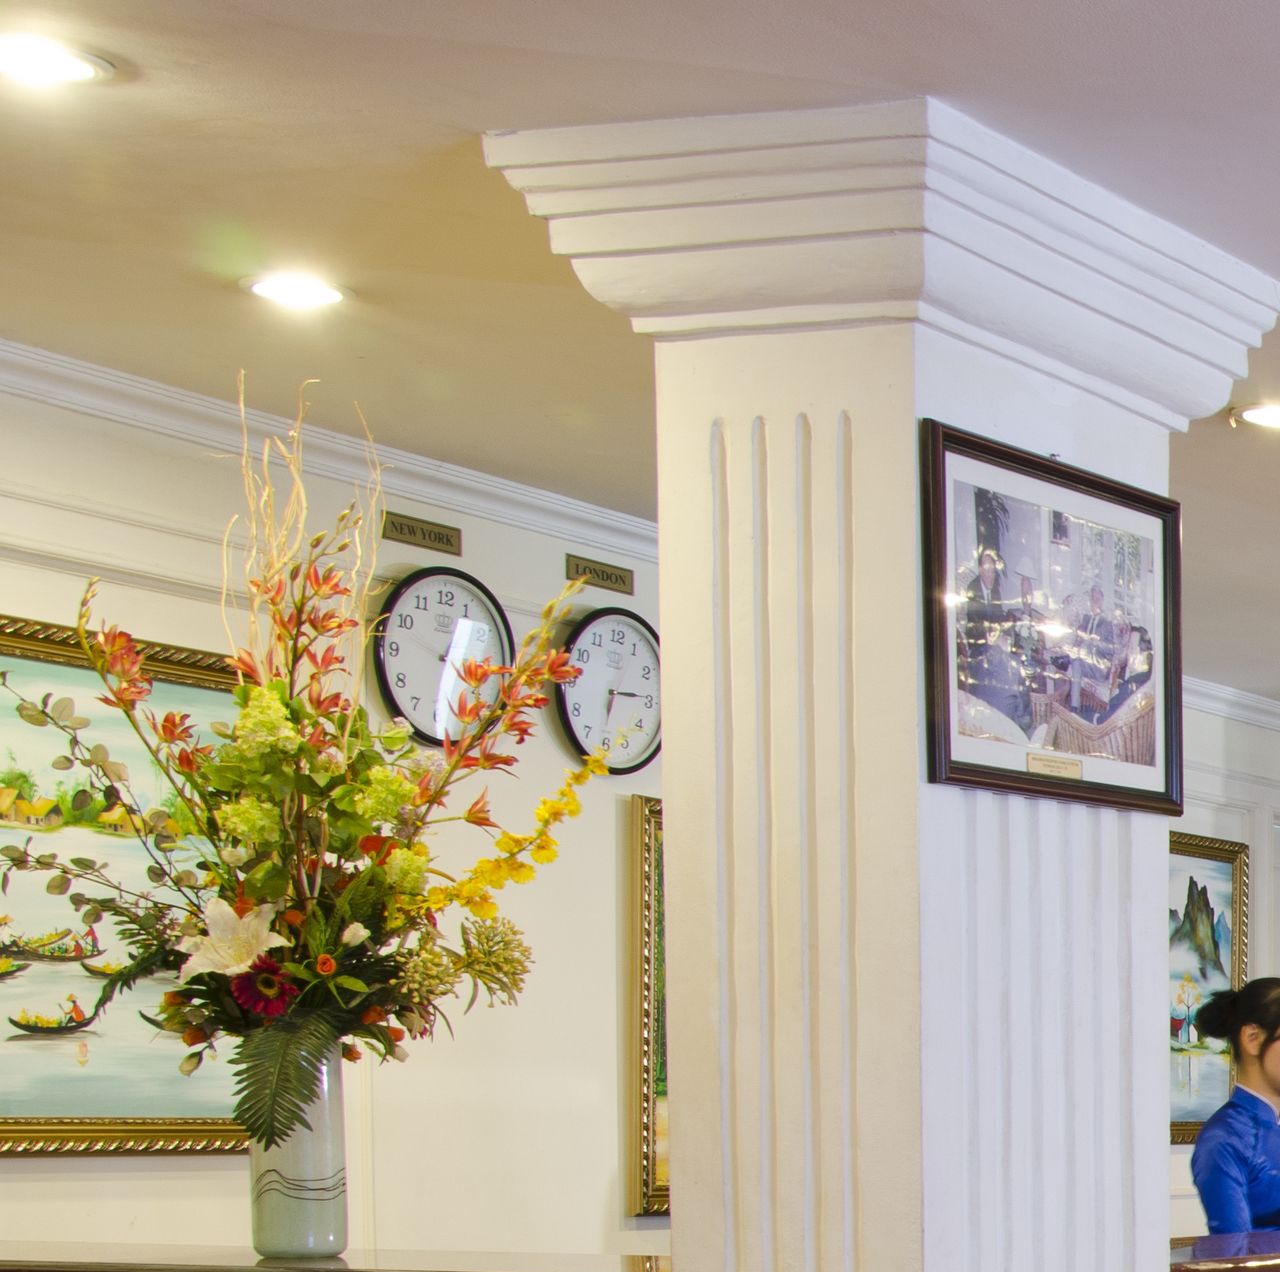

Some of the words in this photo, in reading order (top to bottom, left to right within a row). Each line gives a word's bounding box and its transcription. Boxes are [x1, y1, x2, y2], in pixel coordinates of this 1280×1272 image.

[391, 519, 418, 537] NEW
[420, 527, 454, 547] YORK
[575, 563, 627, 586] LONDON
[414, 594, 429, 611] 11
[437, 589, 455, 607] 12
[463, 603, 469, 618] 1
[397, 613, 414, 630] 10
[476, 627, 486, 643] 2
[591, 632, 603, 647] 11
[610, 629, 625, 645] 12
[389, 641, 399, 657] 9
[576, 648, 590, 663] 10
[631, 643, 637, 656] 1
[395, 672, 406, 688] 8
[642, 665, 651, 680] 2
[410, 696, 420, 711] 7
[644, 694, 653, 709] 3
[571, 702, 581, 717] 8
[634, 718, 643, 729] 4
[583, 725, 592, 739] 7
[602, 737, 610, 752] 6
